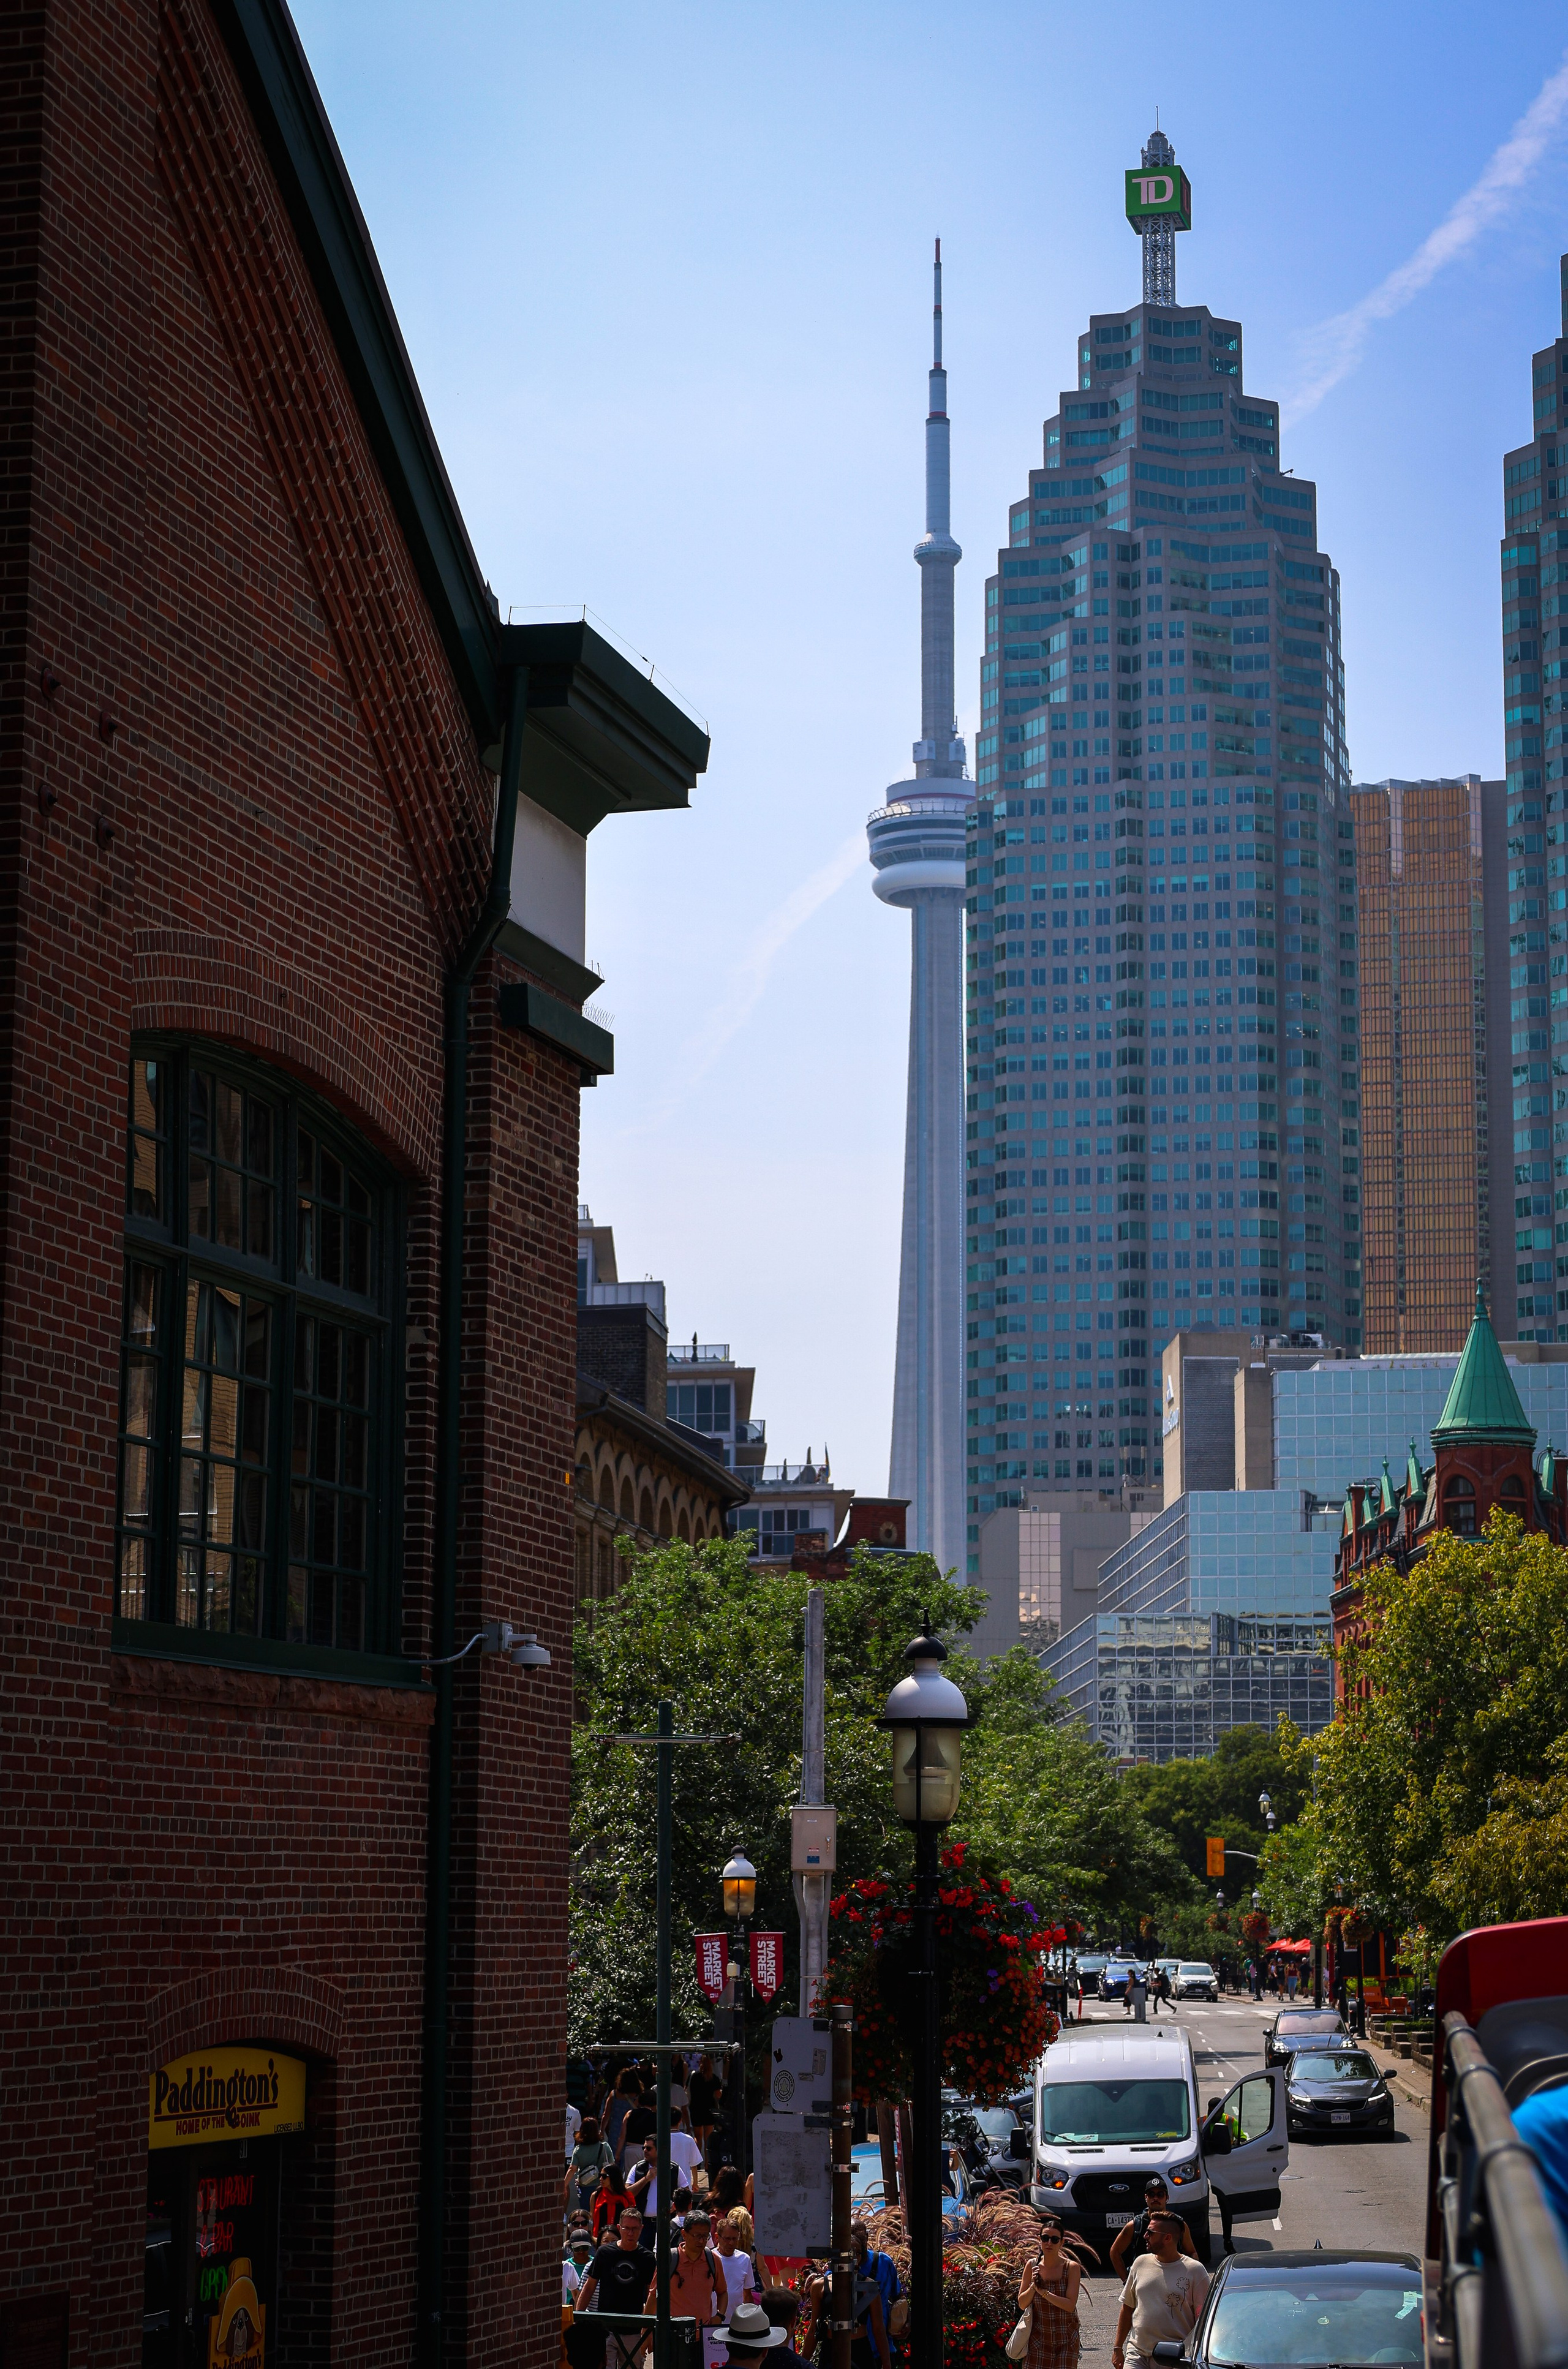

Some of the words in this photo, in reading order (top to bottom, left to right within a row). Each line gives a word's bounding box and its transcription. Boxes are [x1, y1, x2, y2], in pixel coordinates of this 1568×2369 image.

[1132, 175, 1174, 205] TD
[703, 1942, 714, 1987] STREET
[712, 1942, 723, 1991] MARKET
[758, 1940, 767, 1986] STREET
[766, 1941, 776, 1991] MARKET
[154, 2058, 279, 2127] Paddington's
[176, 2119, 200, 2136] HOME
[202, 2117, 210, 2130] OF
[212, 2116, 225, 2129] THE
[241, 2112, 260, 2128] OINK
[274, 2123, 293, 2133] LICENSED
[211, 2220, 234, 2255] BAR
